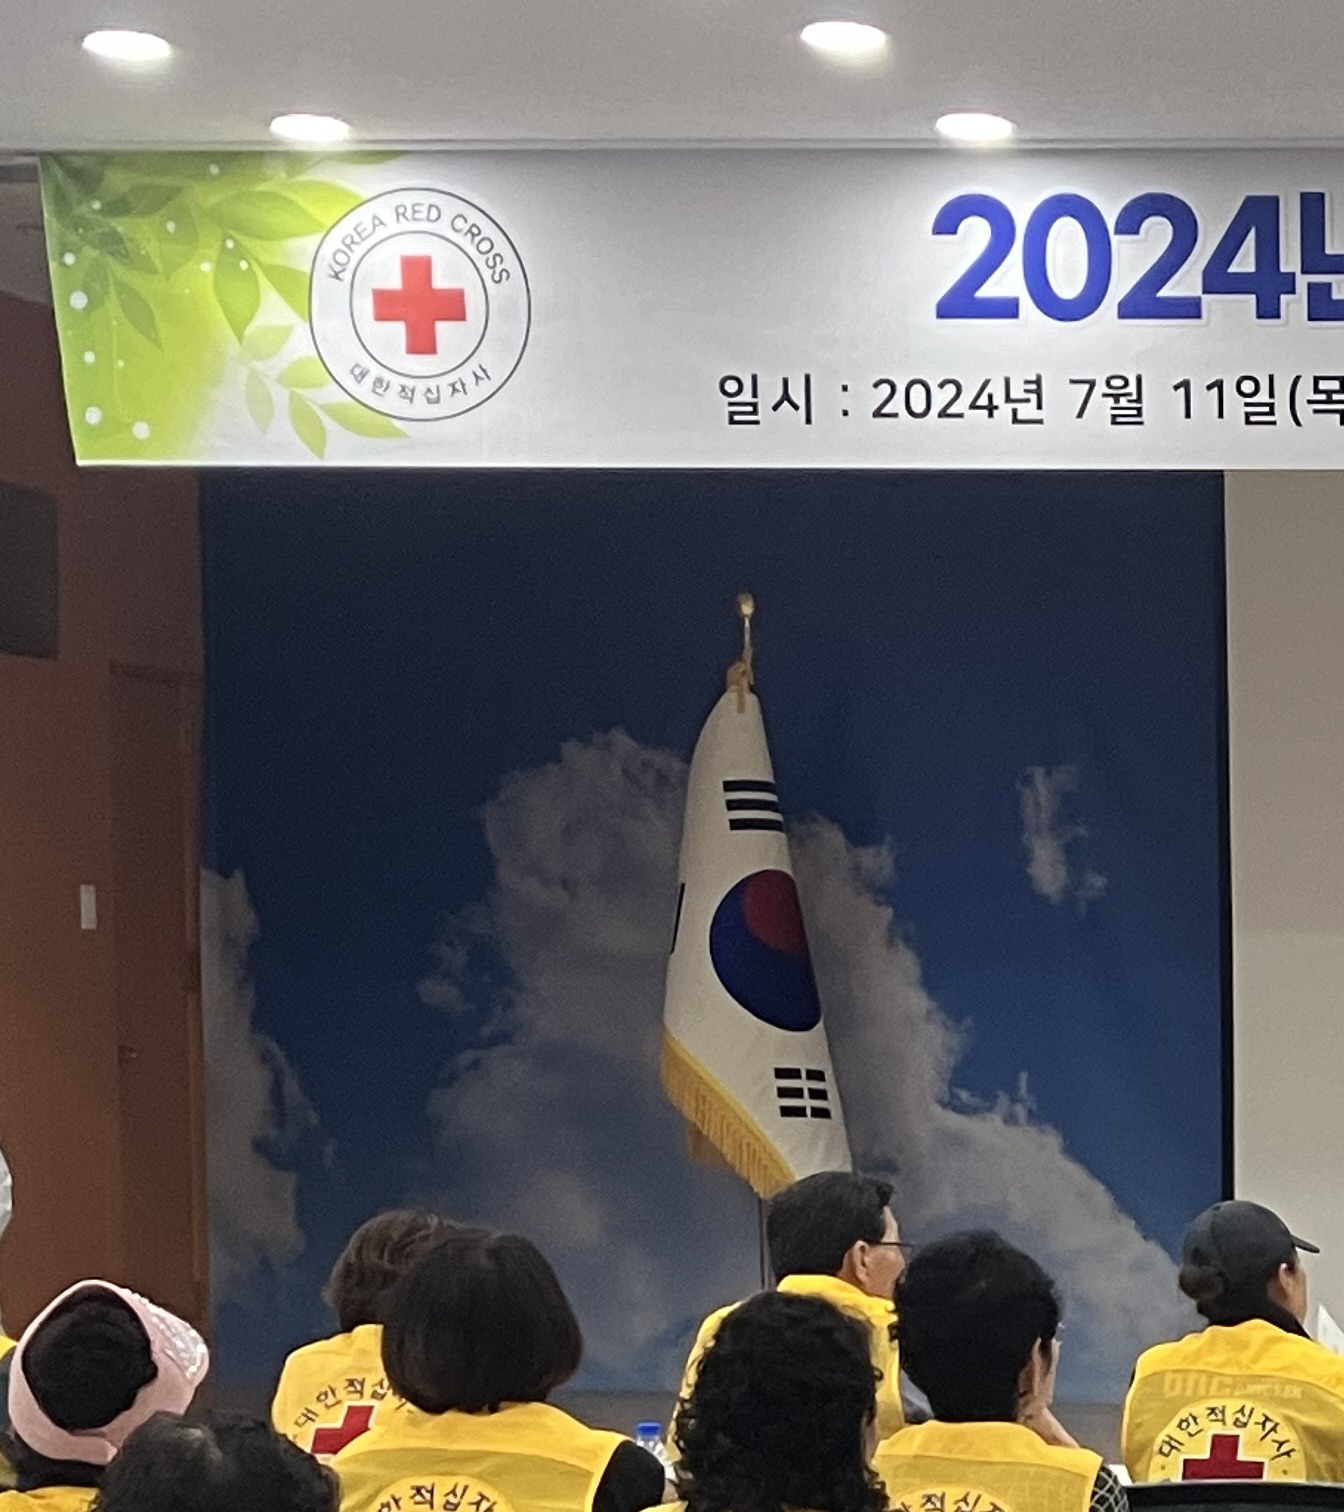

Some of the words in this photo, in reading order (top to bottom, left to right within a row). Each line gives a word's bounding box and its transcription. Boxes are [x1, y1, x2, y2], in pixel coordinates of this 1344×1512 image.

[329, 214, 387, 282] KOREA
[395, 203, 441, 223] RED
[451, 214, 511, 284] CROSS
[350, 363, 492, 405] 대한적십자사
[718, 373, 813, 426] 일시
[872, 373, 1045, 425] 2024년
[1068, 373, 1145, 426] 7월
[293, 1377, 408, 1428] 대한적십
[1158, 1405, 1296, 1461] 대한적십자사
